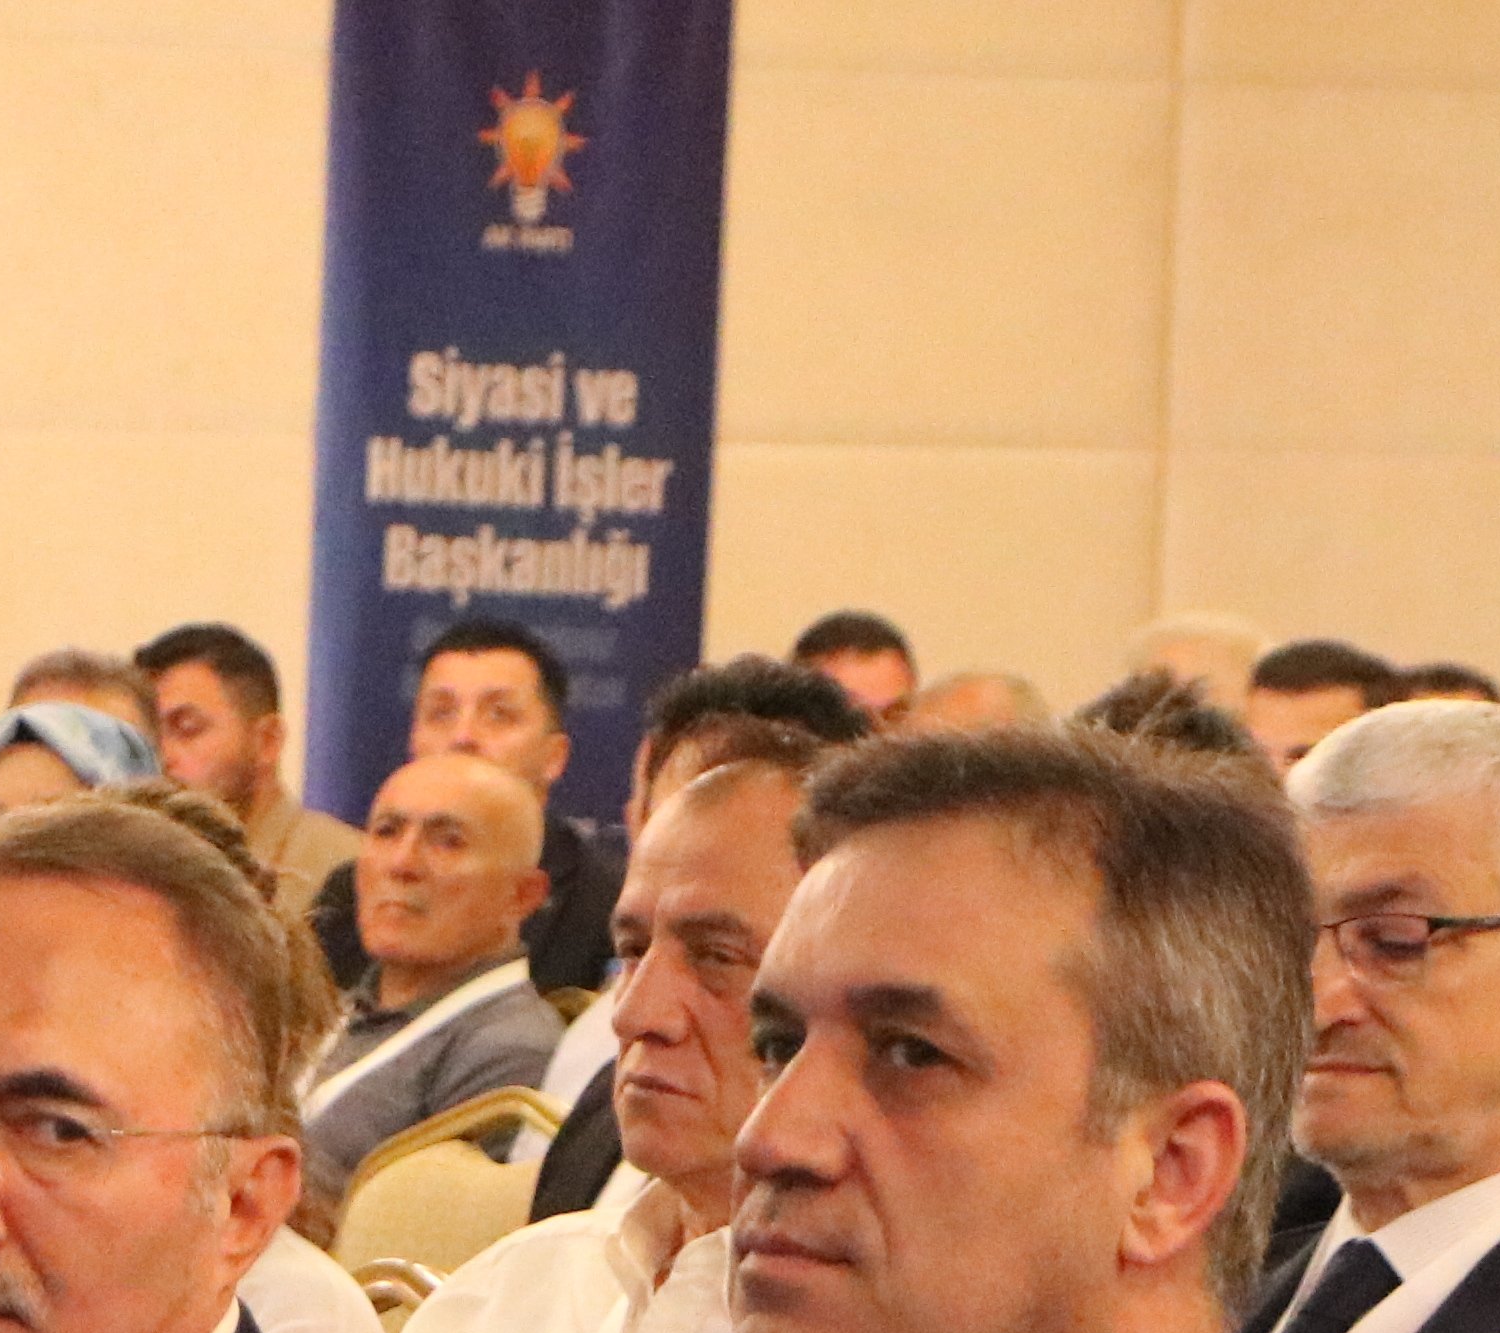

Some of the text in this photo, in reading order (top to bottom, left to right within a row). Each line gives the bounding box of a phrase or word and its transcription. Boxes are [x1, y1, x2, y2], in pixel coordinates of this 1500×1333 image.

[407, 345, 638, 431] Siyasi ve
[365, 431, 674, 524] Hukuki İşler
[383, 523, 649, 610] Başkanlığı
